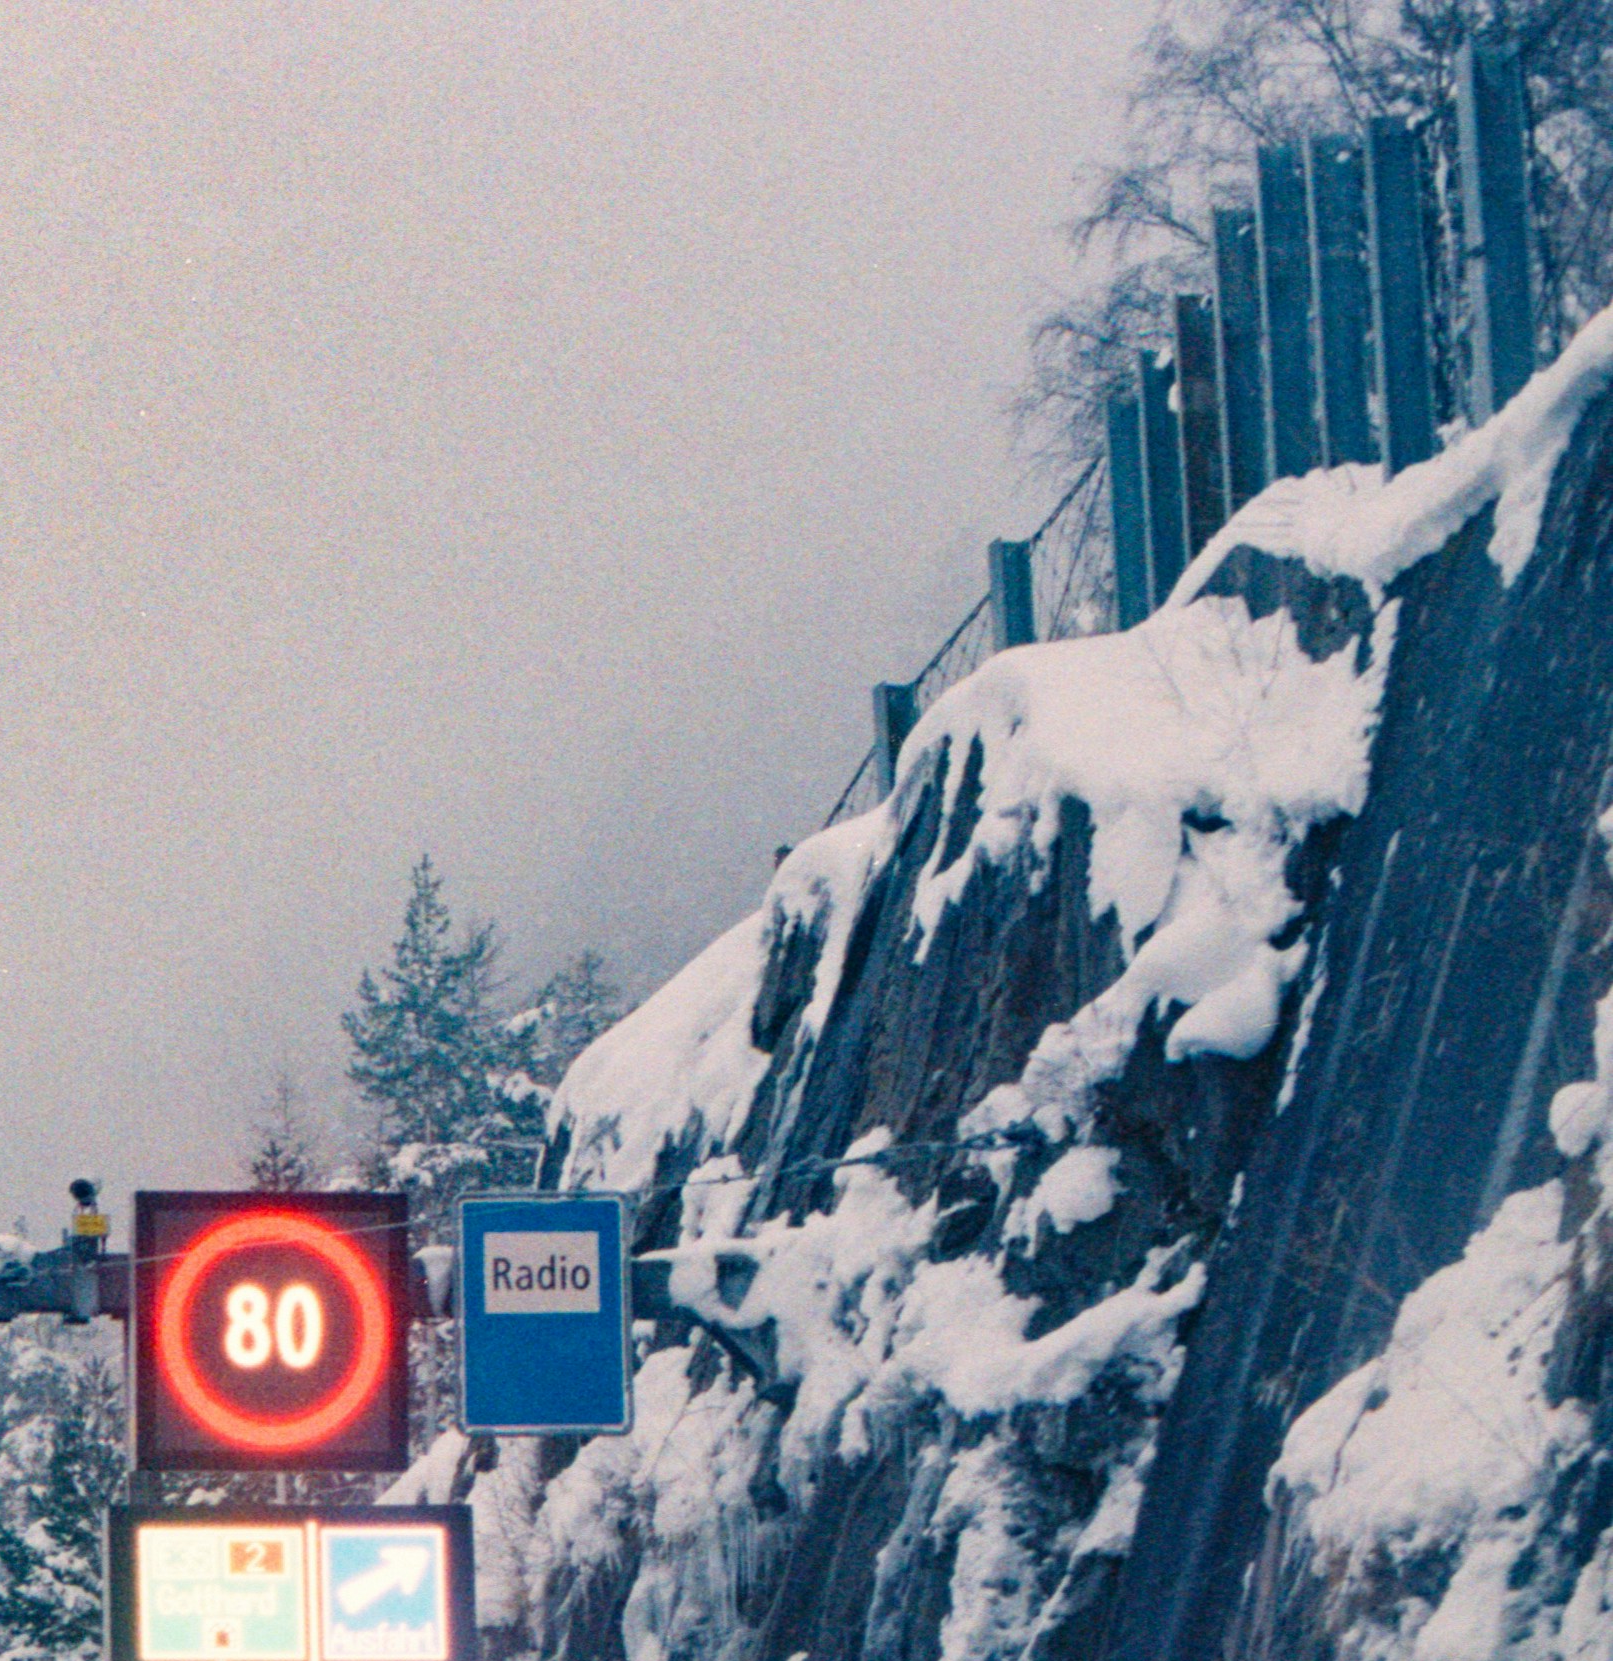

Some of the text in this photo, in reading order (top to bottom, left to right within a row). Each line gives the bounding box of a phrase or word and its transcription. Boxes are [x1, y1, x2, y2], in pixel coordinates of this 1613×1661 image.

[491, 1254, 591, 1292] Radio
[223, 1282, 322, 1370] 80
[243, 1541, 268, 1574] 2
